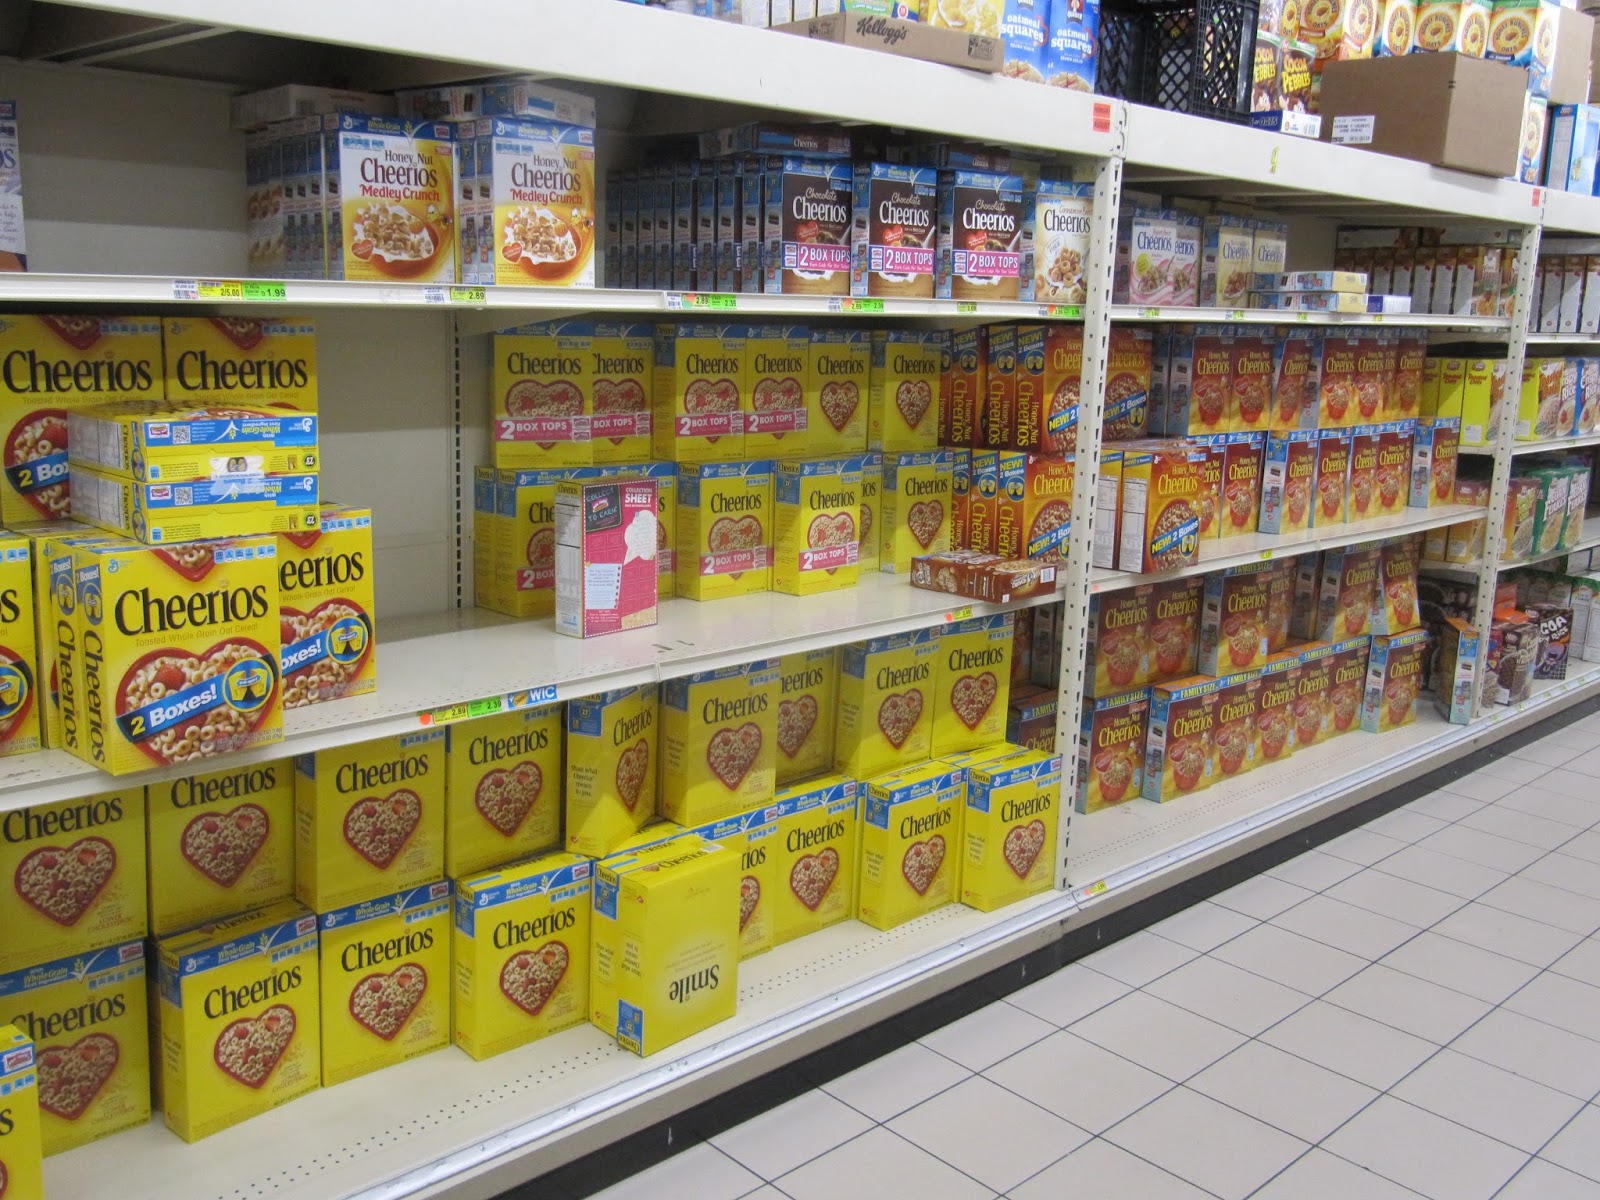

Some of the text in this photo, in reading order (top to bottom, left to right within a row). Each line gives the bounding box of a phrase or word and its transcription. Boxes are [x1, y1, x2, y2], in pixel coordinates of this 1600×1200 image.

[856, 16, 907, 45] Kellogg's
[1007, 15, 1040, 29] oatmeal
[1001, 24, 1044, 43] squares
[1057, 28, 1089, 41] oatmeal
[1051, 38, 1092, 54] squares
[1284, 55, 1308, 74] COCOA
[1282, 71, 1310, 94] PEBBLES
[385, 151, 434, 167] Honey Nut
[533, 155, 577, 171] Honey Nut
[361, 158, 437, 187] Cheerios
[511, 162, 581, 191] Cheerios
[359, 185, 440, 202] Medley Crunch
[510, 188, 583, 206] Medley Crunch
[805, 187, 837, 202] Chocolate
[892, 193, 921, 206] Chocolate
[793, 196, 847, 223] Cheerios
[879, 201, 929, 227] Cheerios
[963, 207, 1015, 231] Cheerios
[1044, 209, 1091, 233] Cheerios
[1137, 231, 1172, 251] Cheerios
[1175, 240, 1194, 256] eerios
[800, 246, 809, 266] 2
[810, 248, 828, 261] BOX
[831, 250, 850, 263] TOPS
[886, 252, 894, 269] 2
[895, 252, 912, 265] BOX
[914, 253, 933, 266] TOPS
[969, 254, 977, 272] 2
[979, 255, 996, 268] BOX
[998, 255, 1018, 268] TOPS
[220, 289, 239, 297] 2/5.00
[267, 289, 286, 297] 1.99
[468, 291, 485, 300] 2.89
[724, 299, 736, 307] 2.39
[1018, 329, 1043, 346] NEW!
[507, 352, 582, 375] Cheerios
[686, 353, 738, 374] Cheerios
[754, 353, 802, 374] Cheerios
[817, 355, 864, 375] Cheerios
[893, 354, 935, 374] Cheerios
[1053, 348, 1082, 370] Cheer
[2, 350, 152, 394] Cheerios
[176, 350, 308, 391] Cheerios
[952, 379, 968, 443] Cheerios
[988, 381, 1005, 445] Cheerios
[1127, 395, 1147, 410] Boxes
[593, 418, 632, 428] BOX TOPS
[1017, 381, 1034, 447] Cheerios
[1049, 414, 1069, 430] NEW!
[500, 421, 567, 440] 2 BOX TOPS
[680, 416, 728, 434] 2 BOX TOPS
[18, 457, 68, 487] 2 Box
[1000, 458, 1023, 471] NEW!
[905, 477, 948, 497] Cheerios
[1033, 474, 1073, 496] Cheerio
[1158, 474, 1198, 496] Cheerios
[625, 494, 652, 503] SHEET
[711, 493, 762, 513] Cheerios
[810, 490, 855, 511] Cheerios
[1029, 533, 1057, 555] NEW! 2
[1152, 520, 1198, 554] NEW! 2 Boxes
[704, 552, 751, 574] 2 BOX TOPS
[803, 549, 845, 570] 2 BOX TOPS
[80, 567, 99, 582] Boxes!
[278, 551, 364, 593] eerios
[522, 570, 534, 588] 2
[115, 584, 269, 636] Cheerios
[1157, 598, 1198, 620] Cheerios
[1228, 592, 1267, 614] Cheerios
[1106, 606, 1148, 629] Cheerios
[1540, 616, 1567, 634] COA
[135, 623, 258, 648] Toasted Whole Grain Oat Cereal
[281, 639, 322, 671] oxes!
[948, 646, 1003, 671] Cheerios
[877, 661, 929, 690] Cheerios
[1335, 664, 1365, 683] Cheerios
[1389, 660, 1420, 679] Cheerios
[57, 619, 78, 749] Cheerios
[530, 687, 555, 700] WIC
[1180, 683, 1217, 698] FAMILY SIZE
[1298, 675, 1329, 696] Cheerios
[84, 630, 106, 762] Cheerios
[487, 701, 501, 710] 2.39
[1106, 691, 1145, 708] FAMILY SIZE
[1262, 689, 1296, 709] Cheerios
[130, 683, 217, 736] 2 Boxes!
[452, 707, 466, 716] 2.89
[703, 692, 768, 724] Cheerios
[1219, 700, 1255, 723] Cheerios
[614, 705, 652, 746] Cheerios
[1098, 724, 1141, 747] Cheerios
[1173, 715, 1213, 738] Cheerios
[469, 728, 548, 766] Cheerios
[336, 754, 428, 794] Cheerios
[171, 767, 276, 808] Cheerios
[1001, 793, 1051, 823] Cheerios
[3, 797, 123, 843] Cheerios
[900, 806, 951, 840] Cheerios
[787, 819, 845, 853] Cheerios
[355, 901, 390, 916] Whole Grain
[494, 907, 575, 950] Cheerios
[218, 942, 256, 960] Whole Grain
[341, 927, 433, 972] Cheerios
[204, 966, 301, 1019] Cheerios
[669, 964, 720, 1003] Smile
